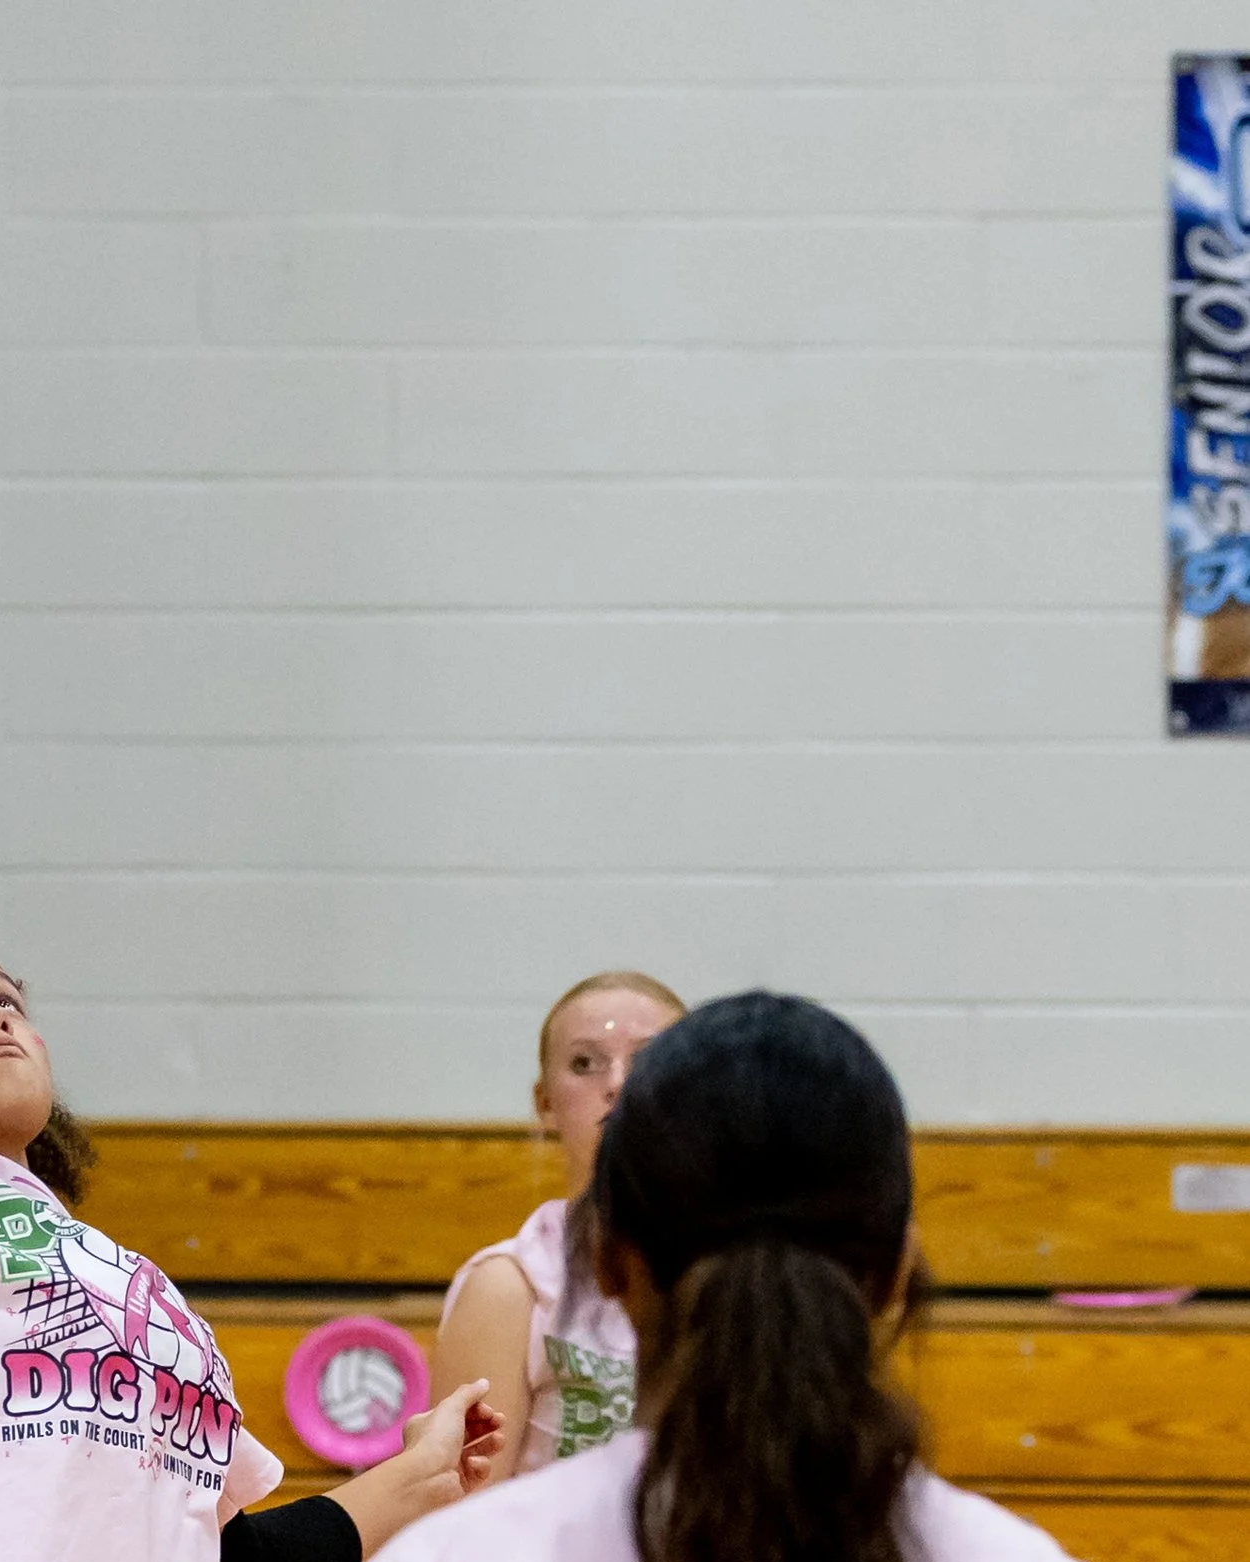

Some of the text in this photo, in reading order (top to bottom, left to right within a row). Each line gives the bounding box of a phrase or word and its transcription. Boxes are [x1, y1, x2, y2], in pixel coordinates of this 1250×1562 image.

[1, 1349, 242, 1466] DIG PIN
[1, 1420, 54, 1442] RIVALS
[60, 1419, 80, 1435] ON
[163, 1452, 193, 1482] UNITED
[195, 1469, 222, 1491] FOR
